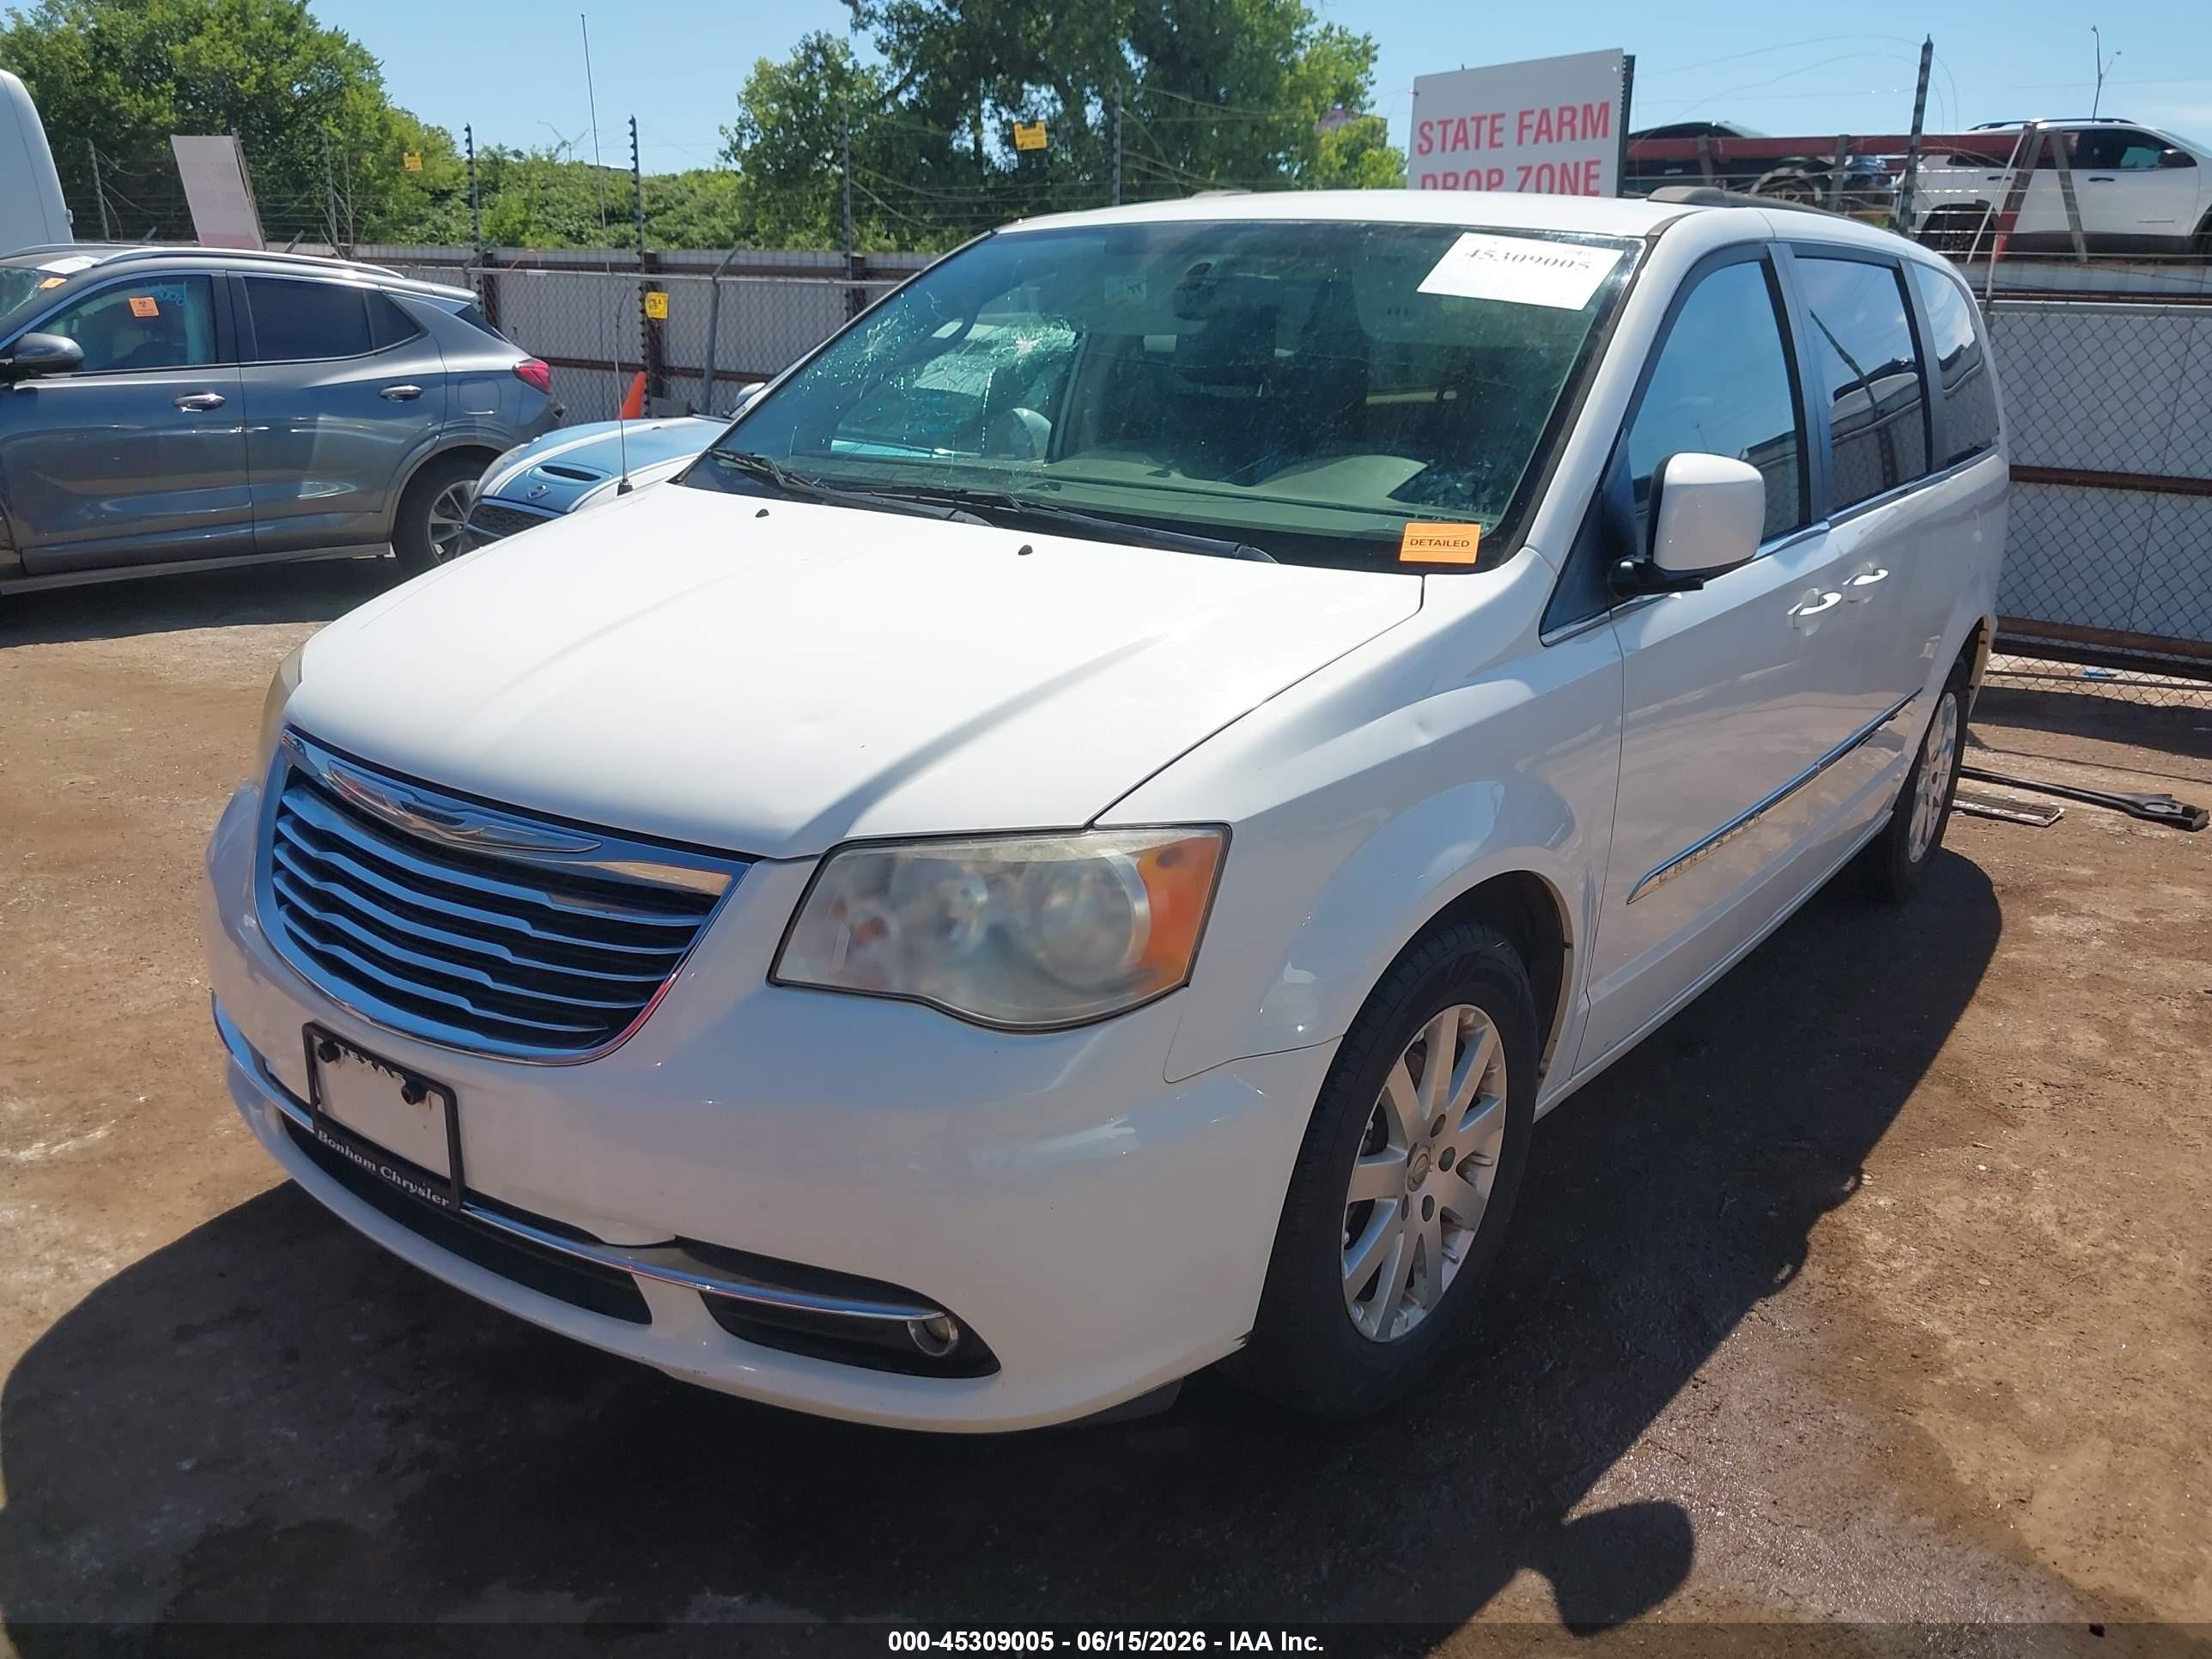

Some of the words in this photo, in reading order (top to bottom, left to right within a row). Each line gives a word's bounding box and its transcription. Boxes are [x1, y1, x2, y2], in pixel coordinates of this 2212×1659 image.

[1417, 112, 1505, 156] STATE
[1516, 100, 1611, 147] FARM
[1516, 160, 1601, 197] ZONE
[1410, 538, 1470, 547] DETAILED
[317, 1129, 376, 1171] Bonham
[380, 1165, 449, 1207] Chrysler
